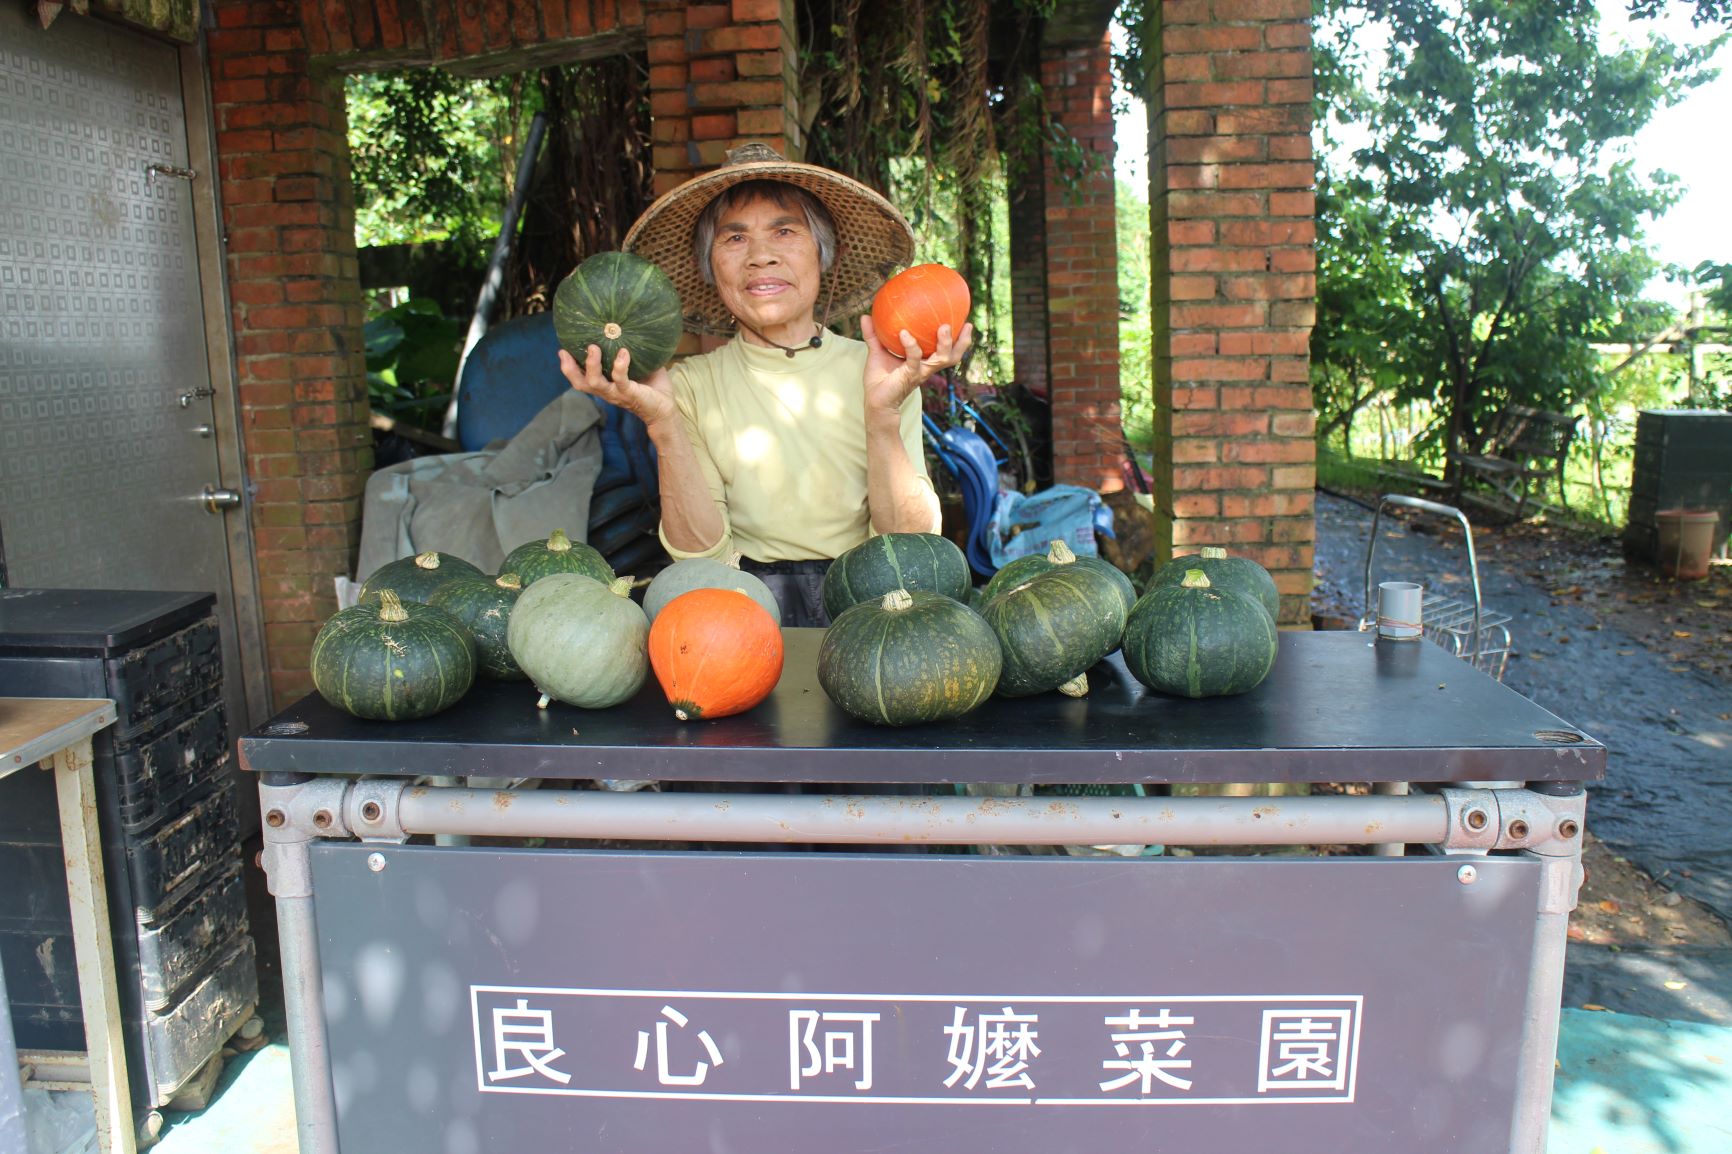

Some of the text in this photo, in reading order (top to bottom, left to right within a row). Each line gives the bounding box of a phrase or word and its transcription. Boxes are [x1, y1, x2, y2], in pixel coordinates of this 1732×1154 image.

[487, 999, 1352, 1094] 良心阿嬤菜園
